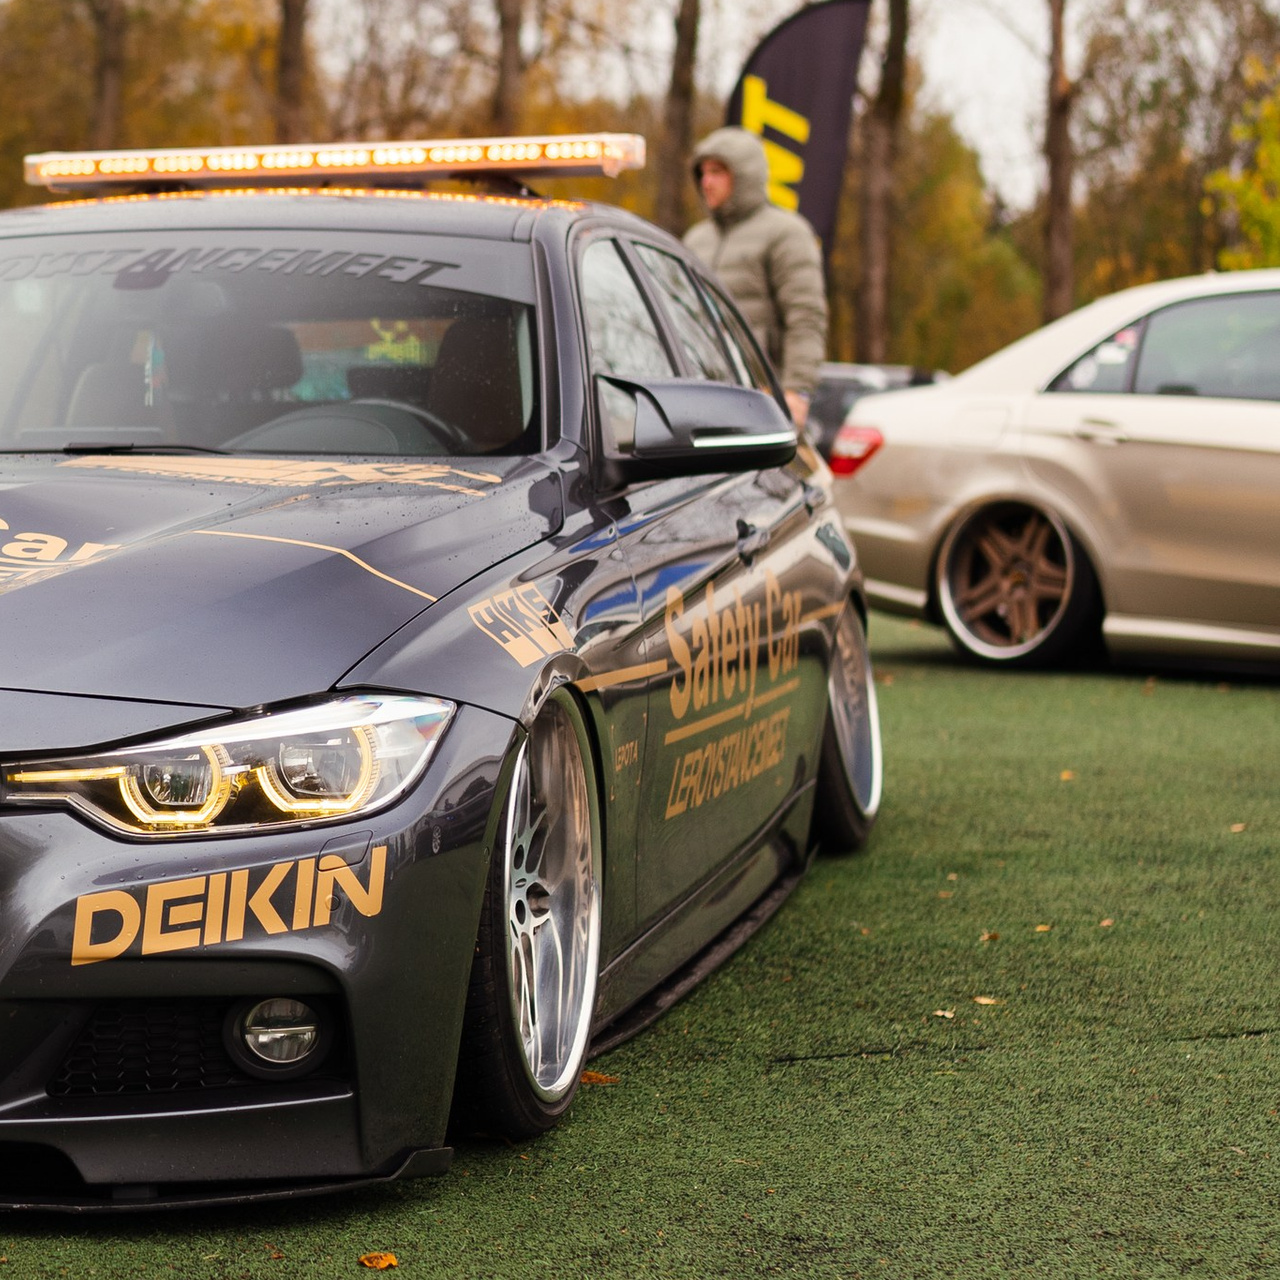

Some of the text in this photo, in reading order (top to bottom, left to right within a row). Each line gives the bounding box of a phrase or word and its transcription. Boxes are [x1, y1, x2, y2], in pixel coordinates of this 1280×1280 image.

[664, 570, 802, 720] Safety Car
[71, 845, 388, 966] DEIKIN
